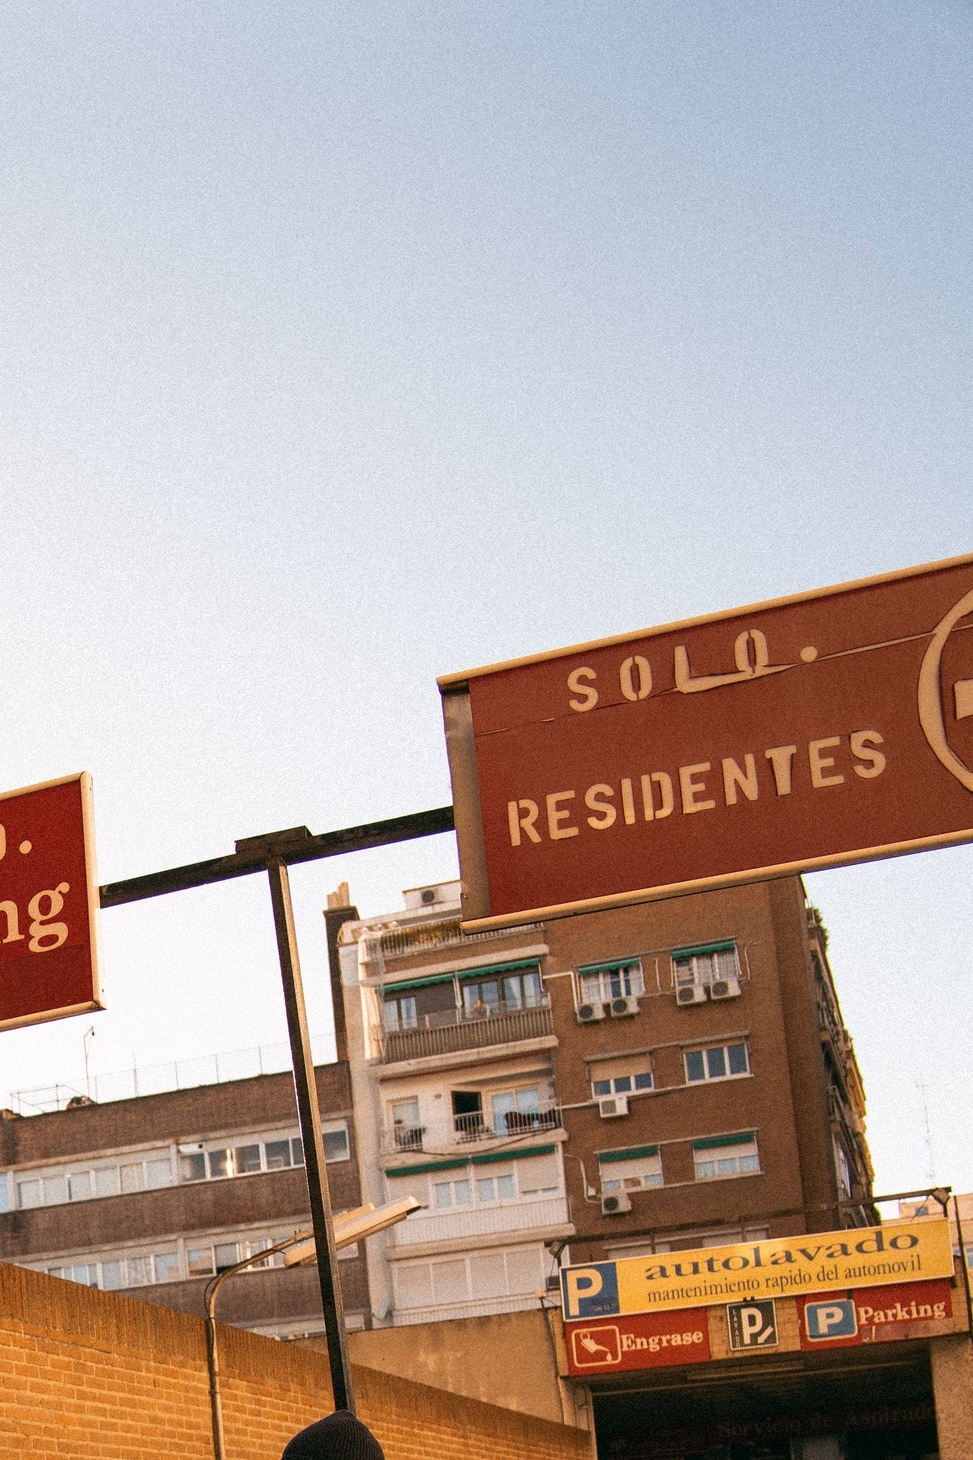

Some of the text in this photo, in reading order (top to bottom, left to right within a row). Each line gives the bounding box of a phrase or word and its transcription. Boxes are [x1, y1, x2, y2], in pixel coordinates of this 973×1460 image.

[507, 729, 887, 847] RESIDENTES
[645, 1230, 920, 1281] autolavado
[566, 1267, 603, 1317] P
[647, 1253, 922, 1303] mantenimiento rapido del automovil
[740, 1307, 763, 1345] P
[816, 1306, 844, 1335] P
[857, 1301, 946, 1325] Parking
[620, 1330, 704, 1353] Engrase
